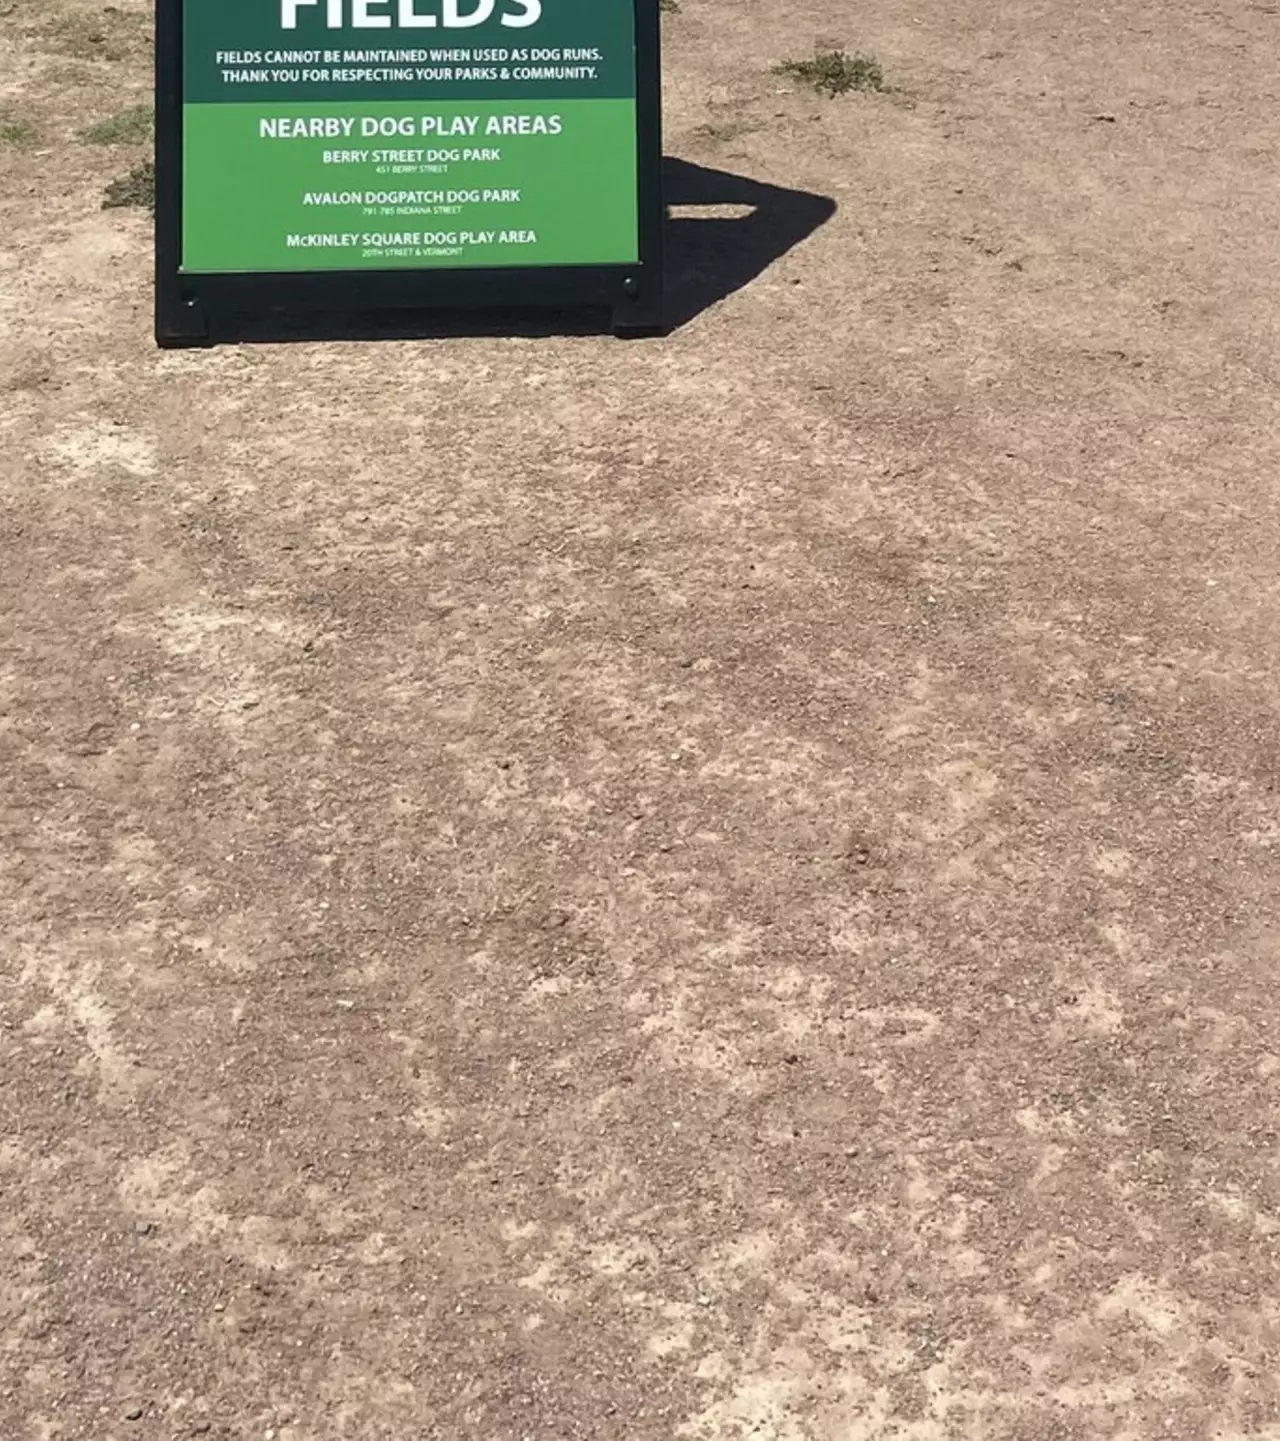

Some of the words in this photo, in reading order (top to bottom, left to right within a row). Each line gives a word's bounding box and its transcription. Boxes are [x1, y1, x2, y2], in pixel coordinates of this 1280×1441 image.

[216, 51, 262, 64] FIELDS
[264, 50, 321, 63] CANNOT
[323, 50, 341, 63] BE
[343, 49, 428, 62] MAINTAINED
[429, 49, 470, 62] WHEN
[473, 49, 509, 61] USED
[510, 48, 529, 61] AS
[530, 48, 561, 61] DOG
[563, 48, 604, 61] RUNS.
[222, 69, 270, 82] THANK
[271, 69, 300, 82] YOU
[302, 69, 330, 82] FOR
[332, 68, 414, 82] RESPECTING
[415, 67, 453, 80] YOUR
[455, 67, 498, 80] PARKS
[499, 67, 510, 80] &
[512, 66, 598, 80] COMMUNITY.
[259, 117, 356, 138] NEARBY
[361, 116, 415, 137] DOG
[421, 115, 480, 136] PLAY
[485, 114, 562, 136] AREAS
[322, 150, 369, 164] BERRY
[371, 149, 425, 163] STREET
[427, 149, 460, 162] DOG
[463, 148, 501, 161] PARK
[419, 164, 448, 173] STREET
[303, 192, 362, 205] AVALON
[365, 190, 444, 204] DOGPATCH
[446, 189, 480, 203] DOG
[482, 189, 521, 202] PARK
[433, 205, 463, 215] STREET
[286, 233, 360, 247] McKINLEY
[362, 232, 421, 247] SQUARE
[423, 231, 457, 245] DOG
[459, 231, 495, 245] PLAY
[498, 230, 537, 243] AREA
[384, 247, 414, 257] STREET
[422, 246, 463, 257] VERMONT
